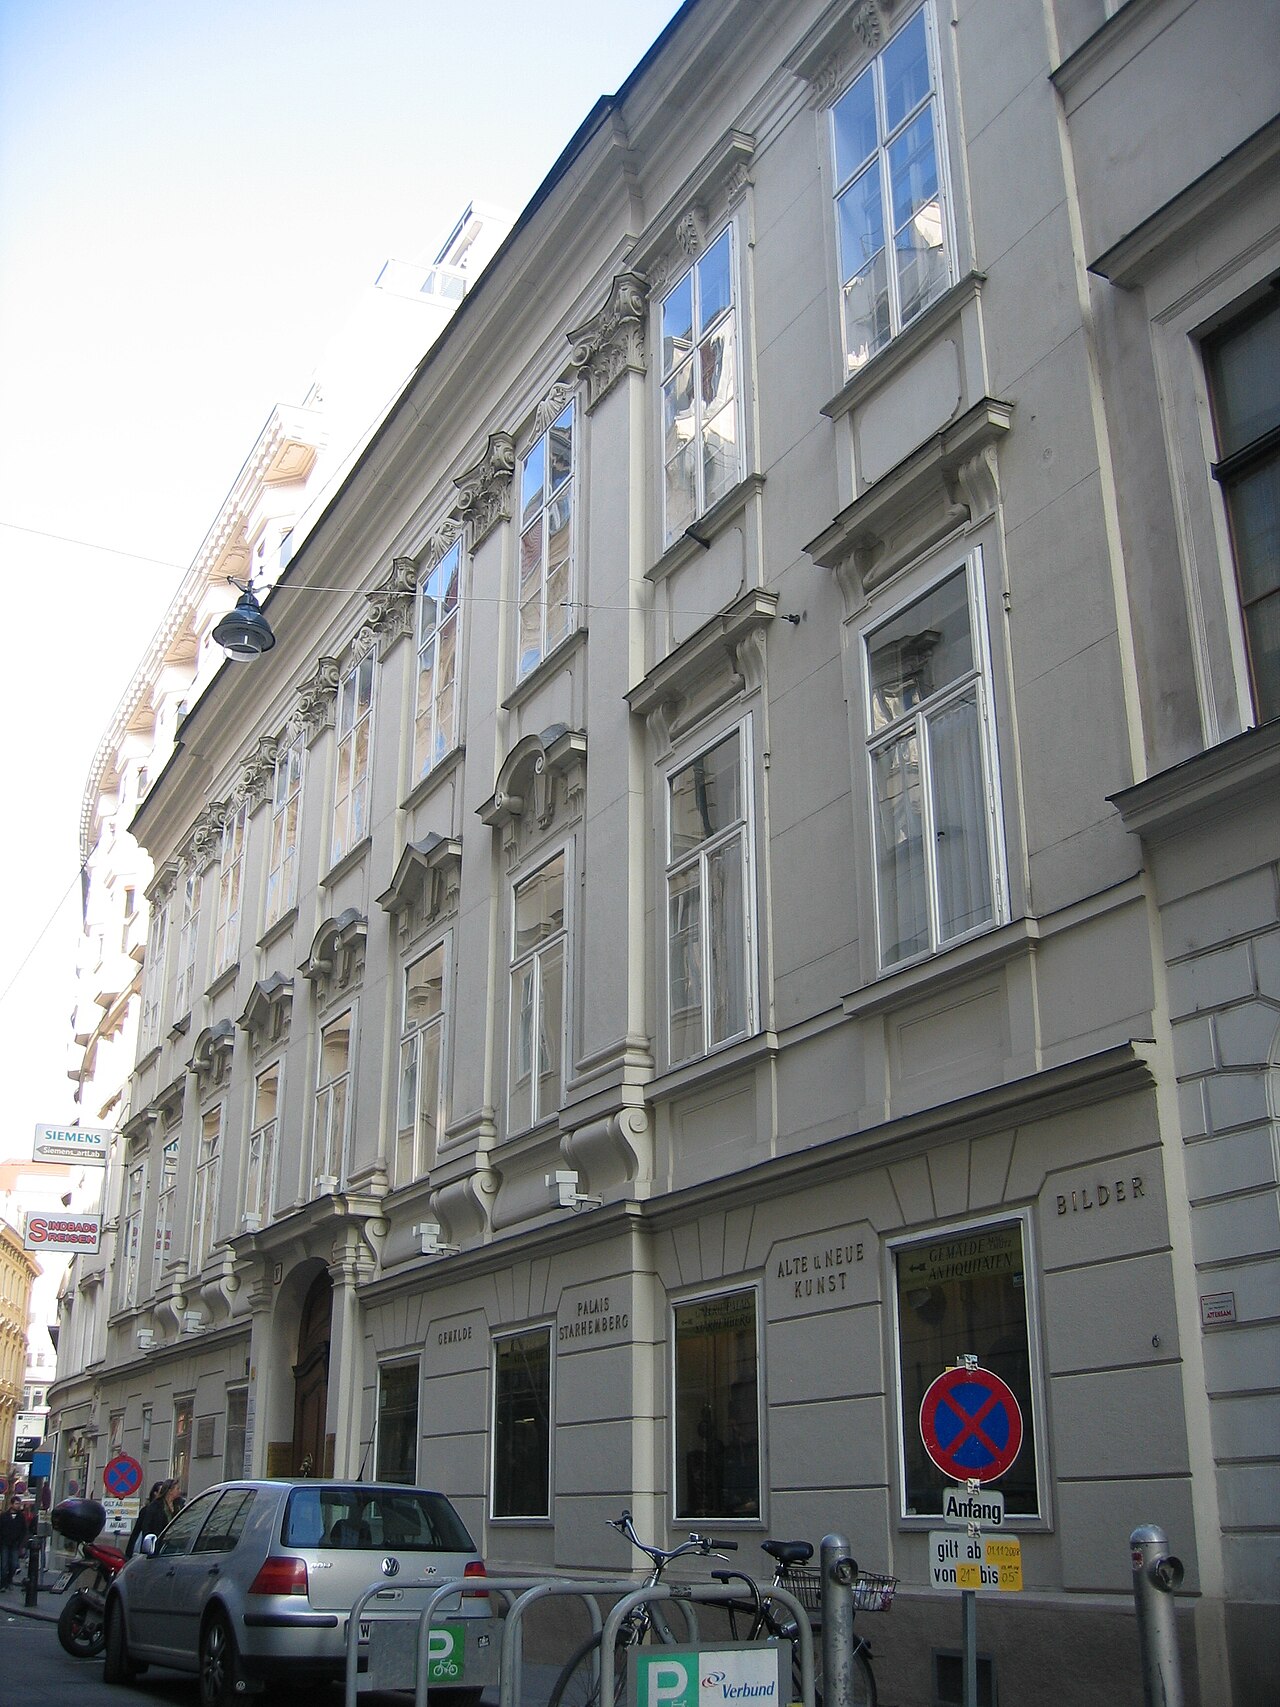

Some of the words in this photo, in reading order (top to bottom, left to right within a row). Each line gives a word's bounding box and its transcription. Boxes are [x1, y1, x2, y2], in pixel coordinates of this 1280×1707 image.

[45, 1130, 101, 1144] SIEMENS
[1056, 1177, 1145, 1215] BILDER
[29, 1218, 98, 1242] SINDBADS
[47, 1233, 97, 1244] REISEN
[778, 1256, 808, 1278] ALTE
[825, 1243, 864, 1268] NEUE
[795, 1272, 847, 1298] KUNST
[577, 1297, 610, 1316] PALAIS
[559, 1314, 629, 1340] STARHEMBERG
[946, 1496, 1001, 1525] Anfang
[937, 1539, 959, 1562] gilt
[967, 1541, 982, 1559] ab
[428, 1566, 434, 1574] A
[934, 1568, 957, 1582] von
[980, 1565, 999, 1584] bis
[360, 1624, 370, 1638] W
[648, 1661, 688, 1707] P
[722, 1681, 775, 1699] Verbund
